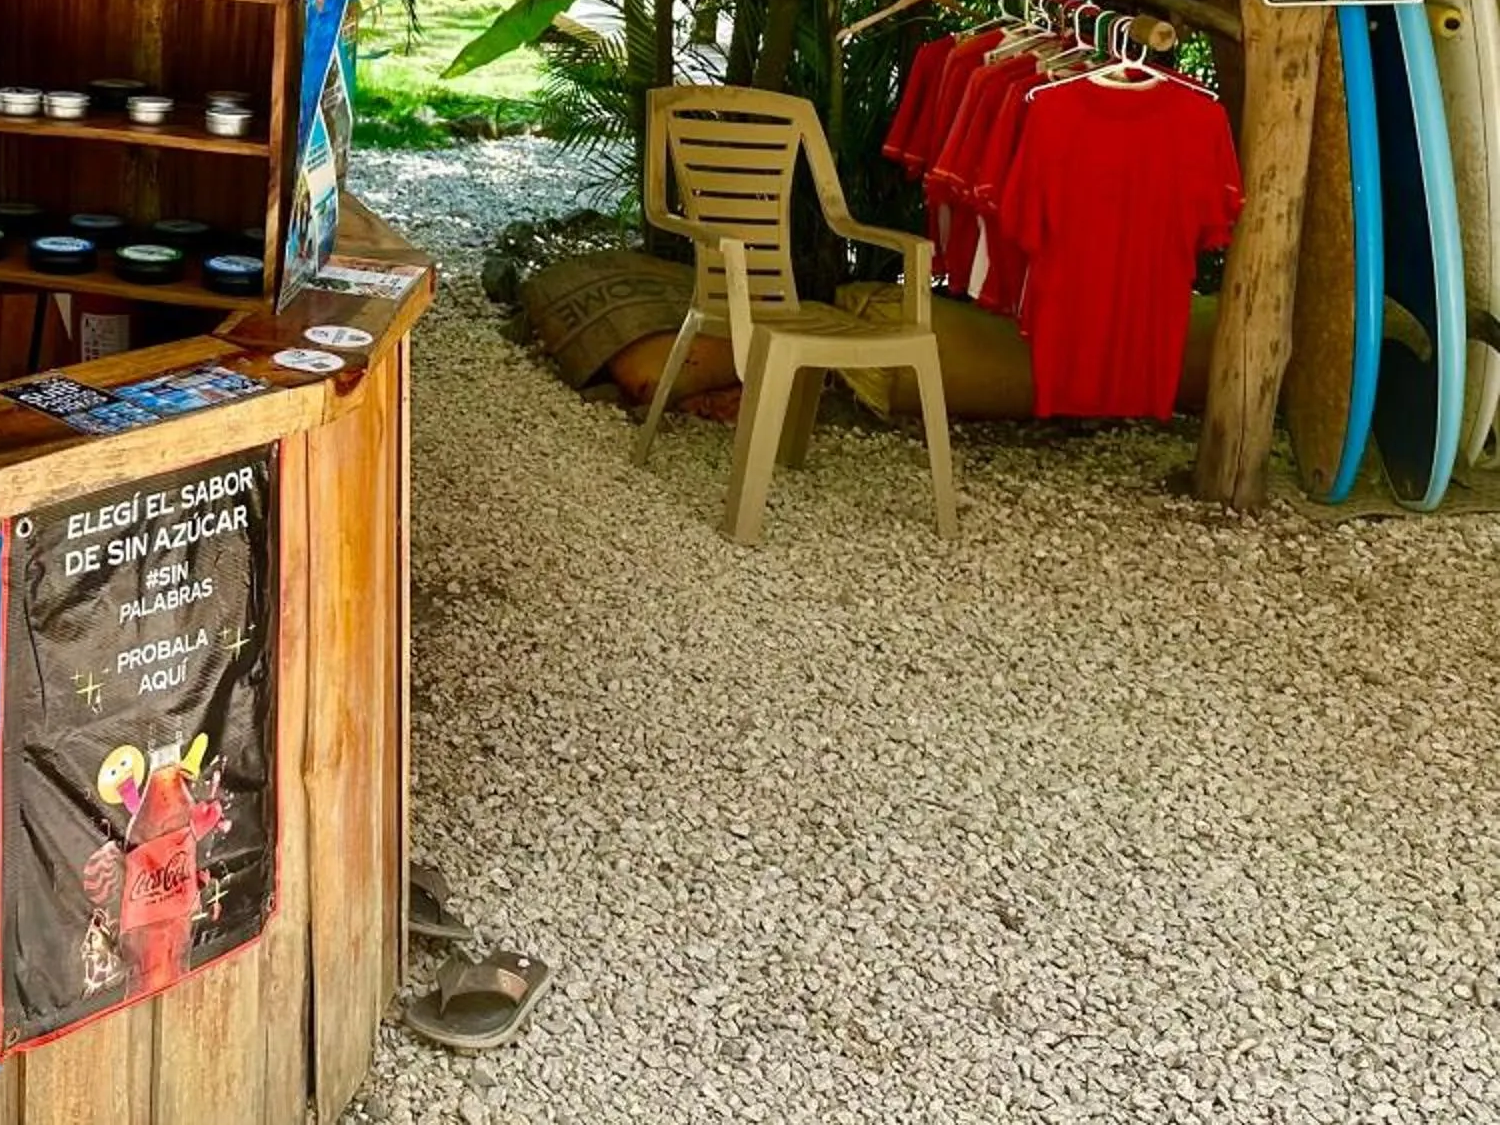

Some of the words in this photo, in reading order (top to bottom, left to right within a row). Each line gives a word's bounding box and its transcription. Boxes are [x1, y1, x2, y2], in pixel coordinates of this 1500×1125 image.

[67, 491, 142, 541] ELEGÍ
[146, 493, 175, 520] EL
[181, 466, 254, 509] SABOR
[65, 544, 101, 577] DE
[107, 531, 149, 566] SIN
[153, 505, 249, 554] AZÚCAR
[145, 561, 189, 591] #SIN
[120, 577, 213, 624] PALABRAS
[117, 628, 209, 674] PROBALA
[138, 658, 189, 696] AQUÍ
